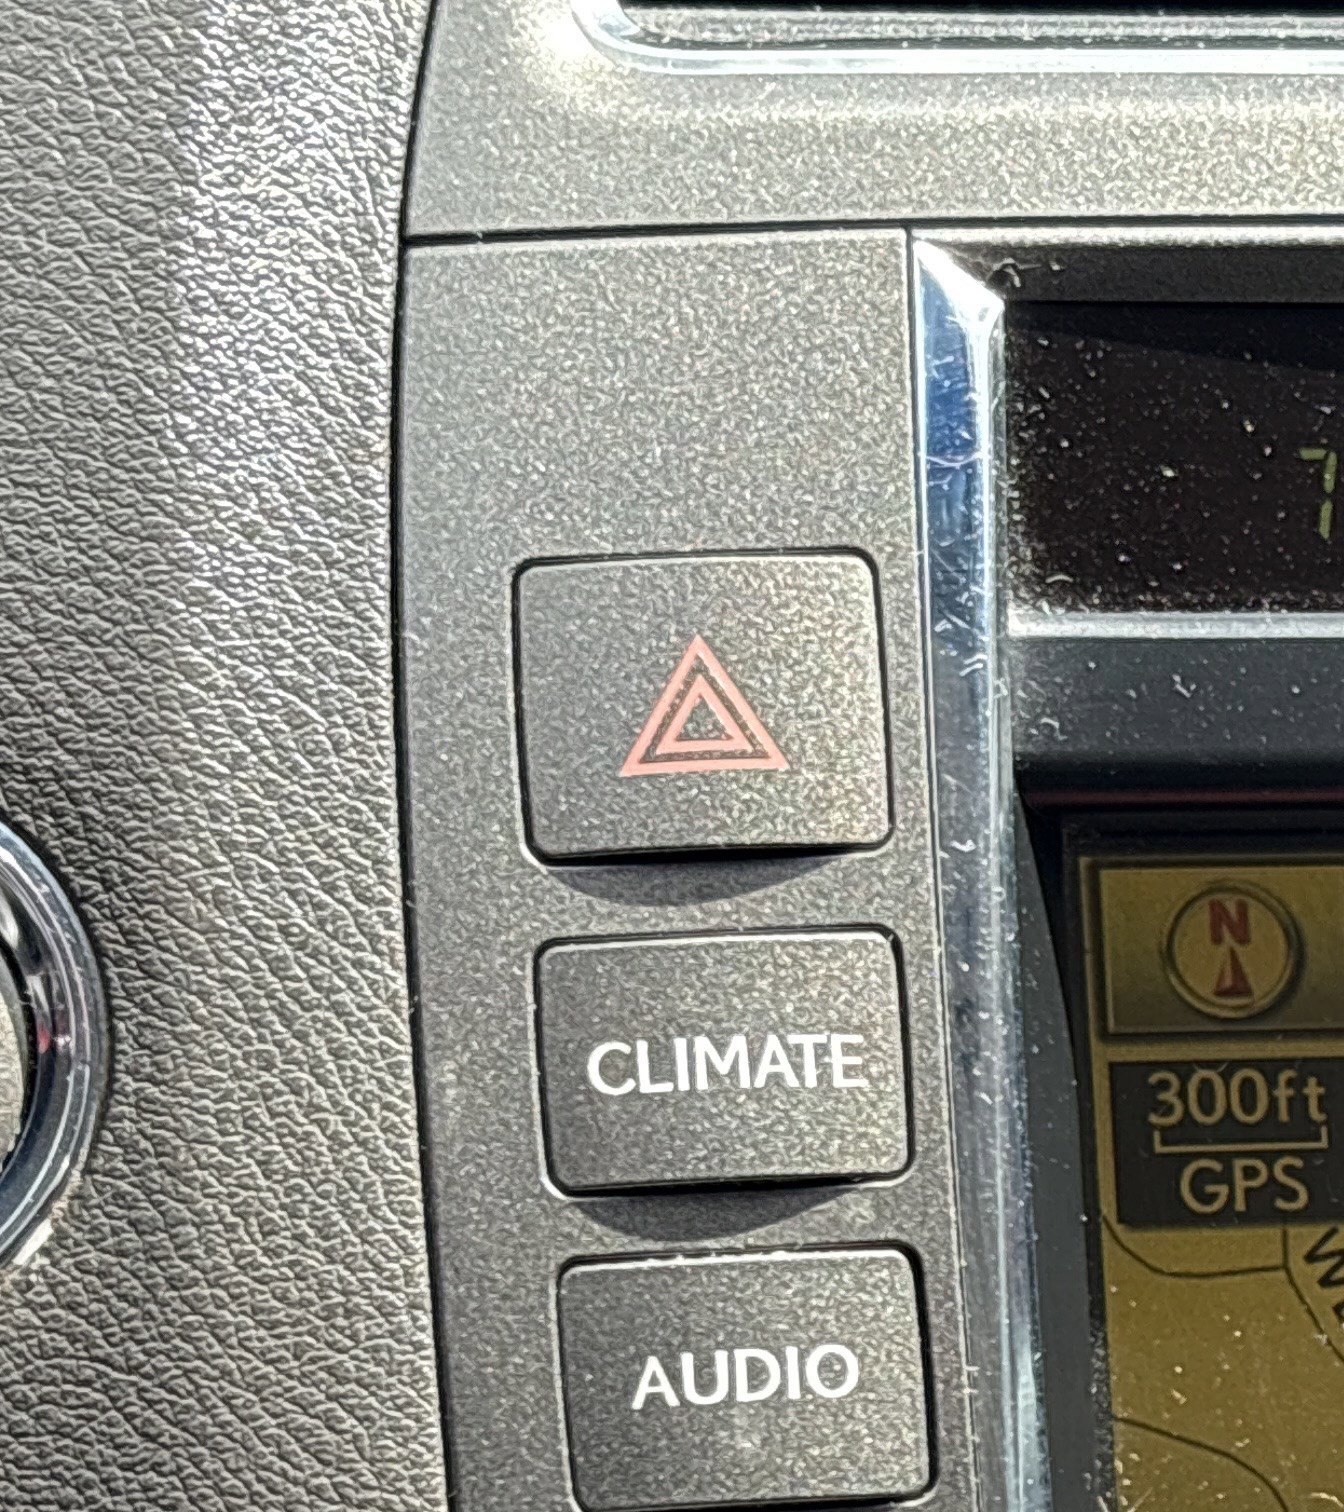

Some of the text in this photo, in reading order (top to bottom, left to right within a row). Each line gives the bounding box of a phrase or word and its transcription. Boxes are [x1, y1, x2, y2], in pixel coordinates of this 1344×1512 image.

[1208, 899, 1252, 946] N
[587, 1034, 867, 1095] CLIMATE
[1147, 1068, 1328, 1127] 300ft
[1180, 1157, 1309, 1214] GPS
[632, 1344, 859, 1409] AUDIO
